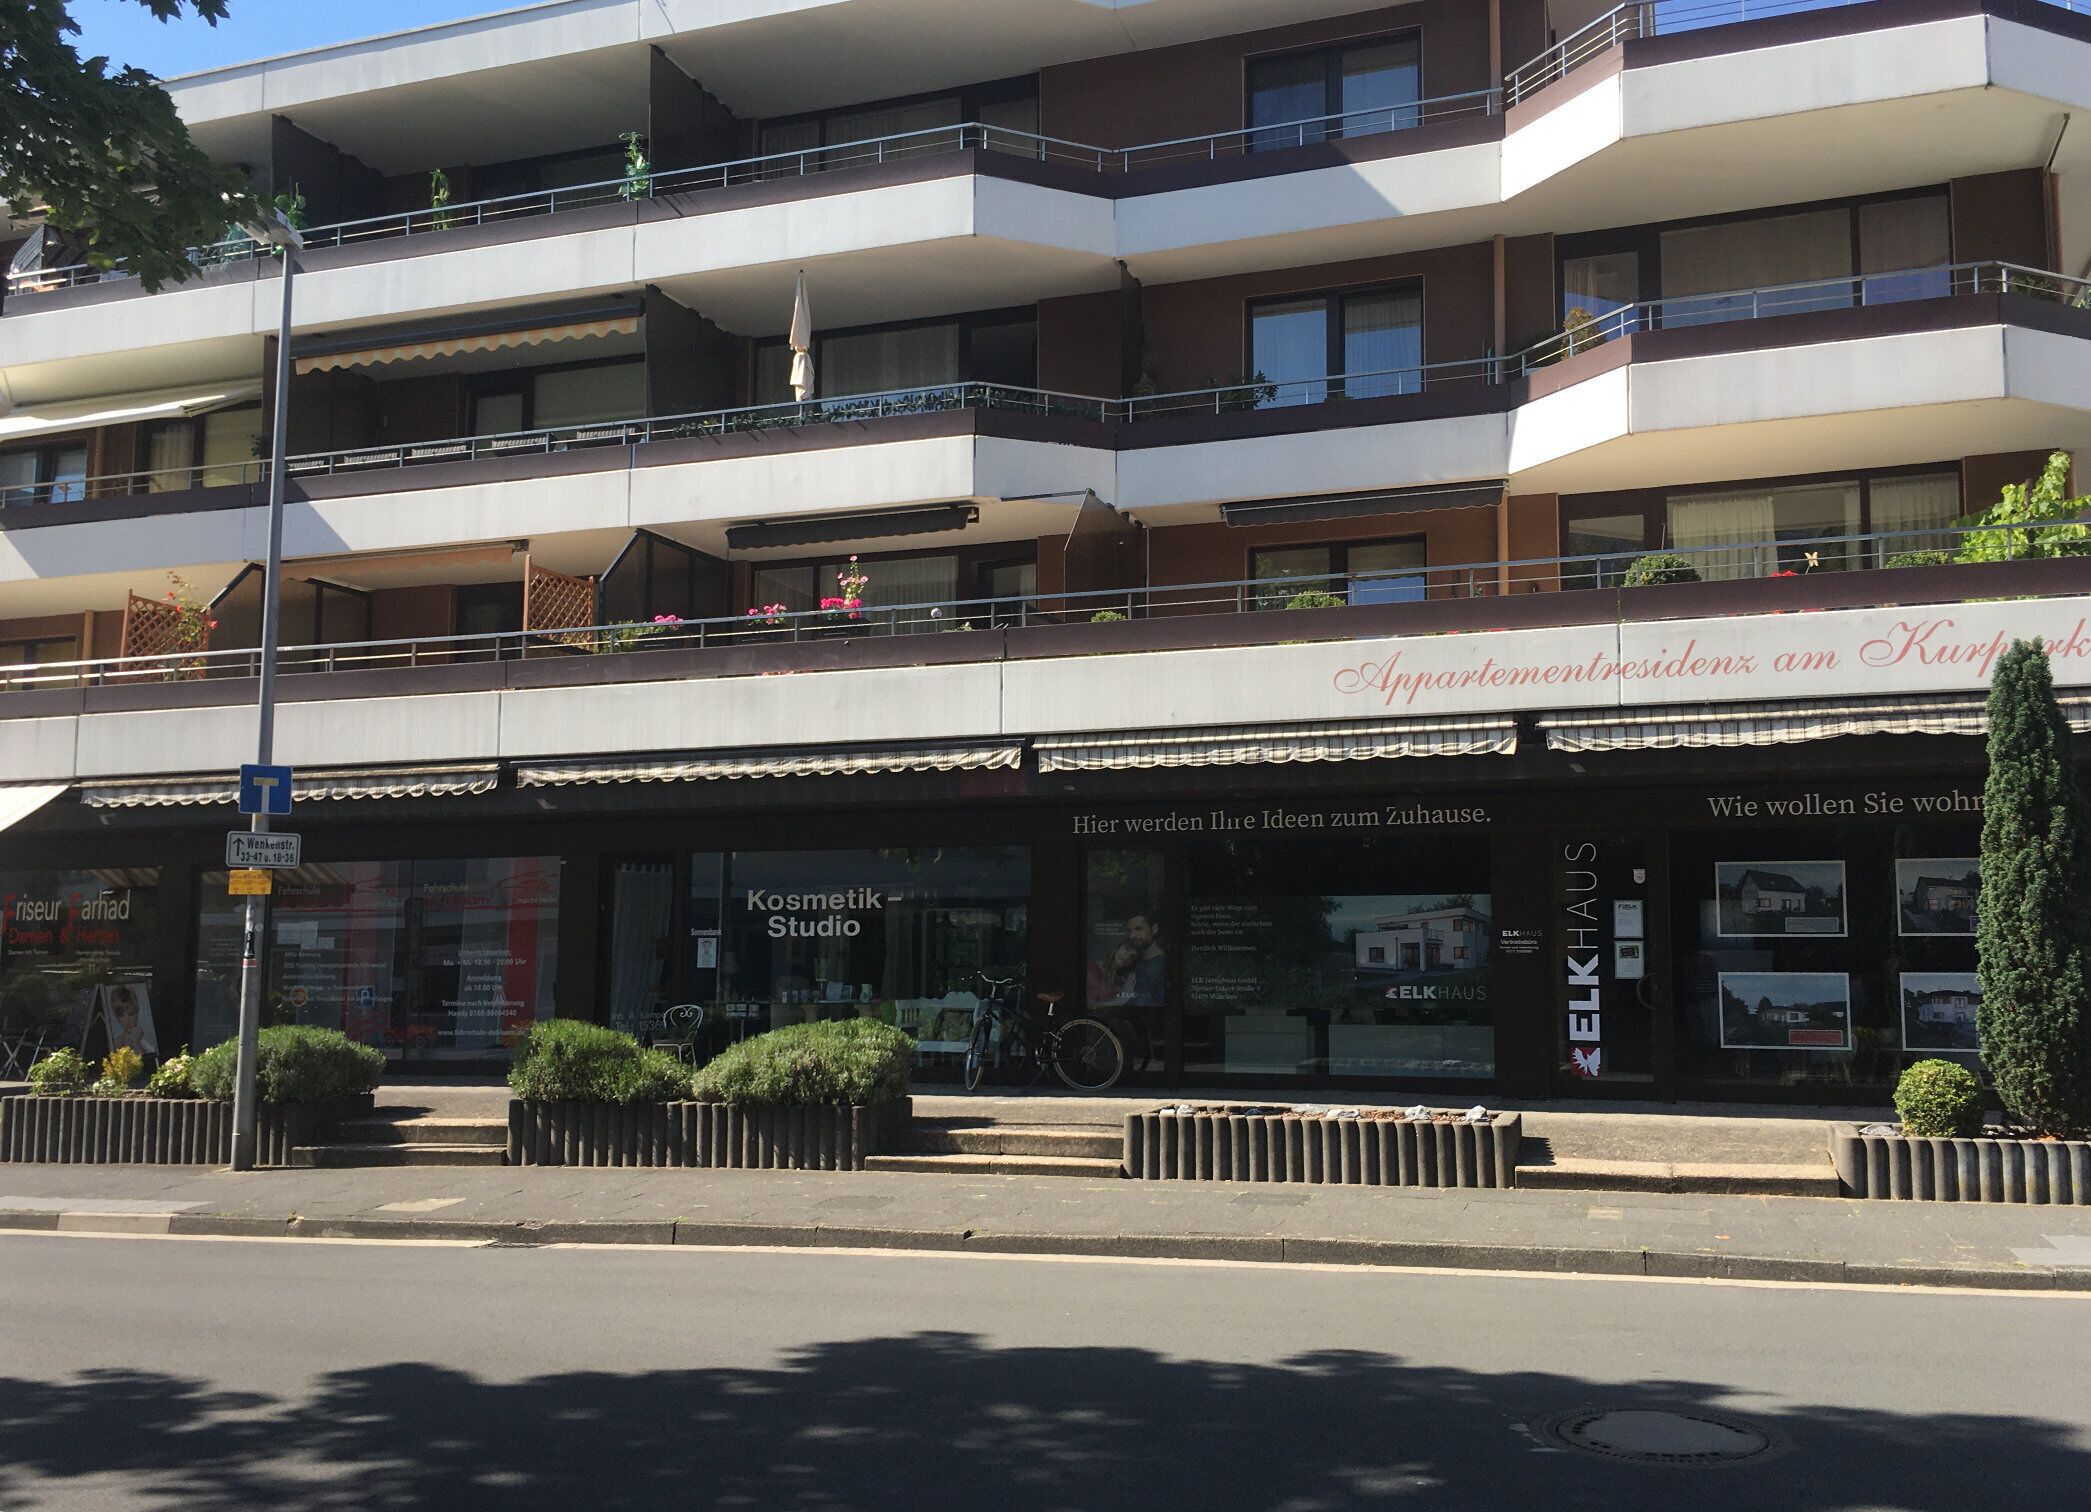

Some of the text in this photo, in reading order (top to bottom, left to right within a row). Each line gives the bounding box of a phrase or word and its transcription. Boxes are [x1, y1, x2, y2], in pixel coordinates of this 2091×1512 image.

[1334, 618, 2091, 705] Appartementresidenz am Kurprk
[1707, 789, 1986, 817] Wie wollen Sie wohn
[1072, 804, 1491, 833] Hier werden Ihre Ideen zum Zuhause.
[424, 882, 469, 893] Fahrschule
[3, 889, 130, 933] Friseur Farhad
[767, 915, 861, 938] Studio
[1565, 843, 1600, 1041] ELKHAUS
[1400, 985, 1487, 1001] ELKHAUS
